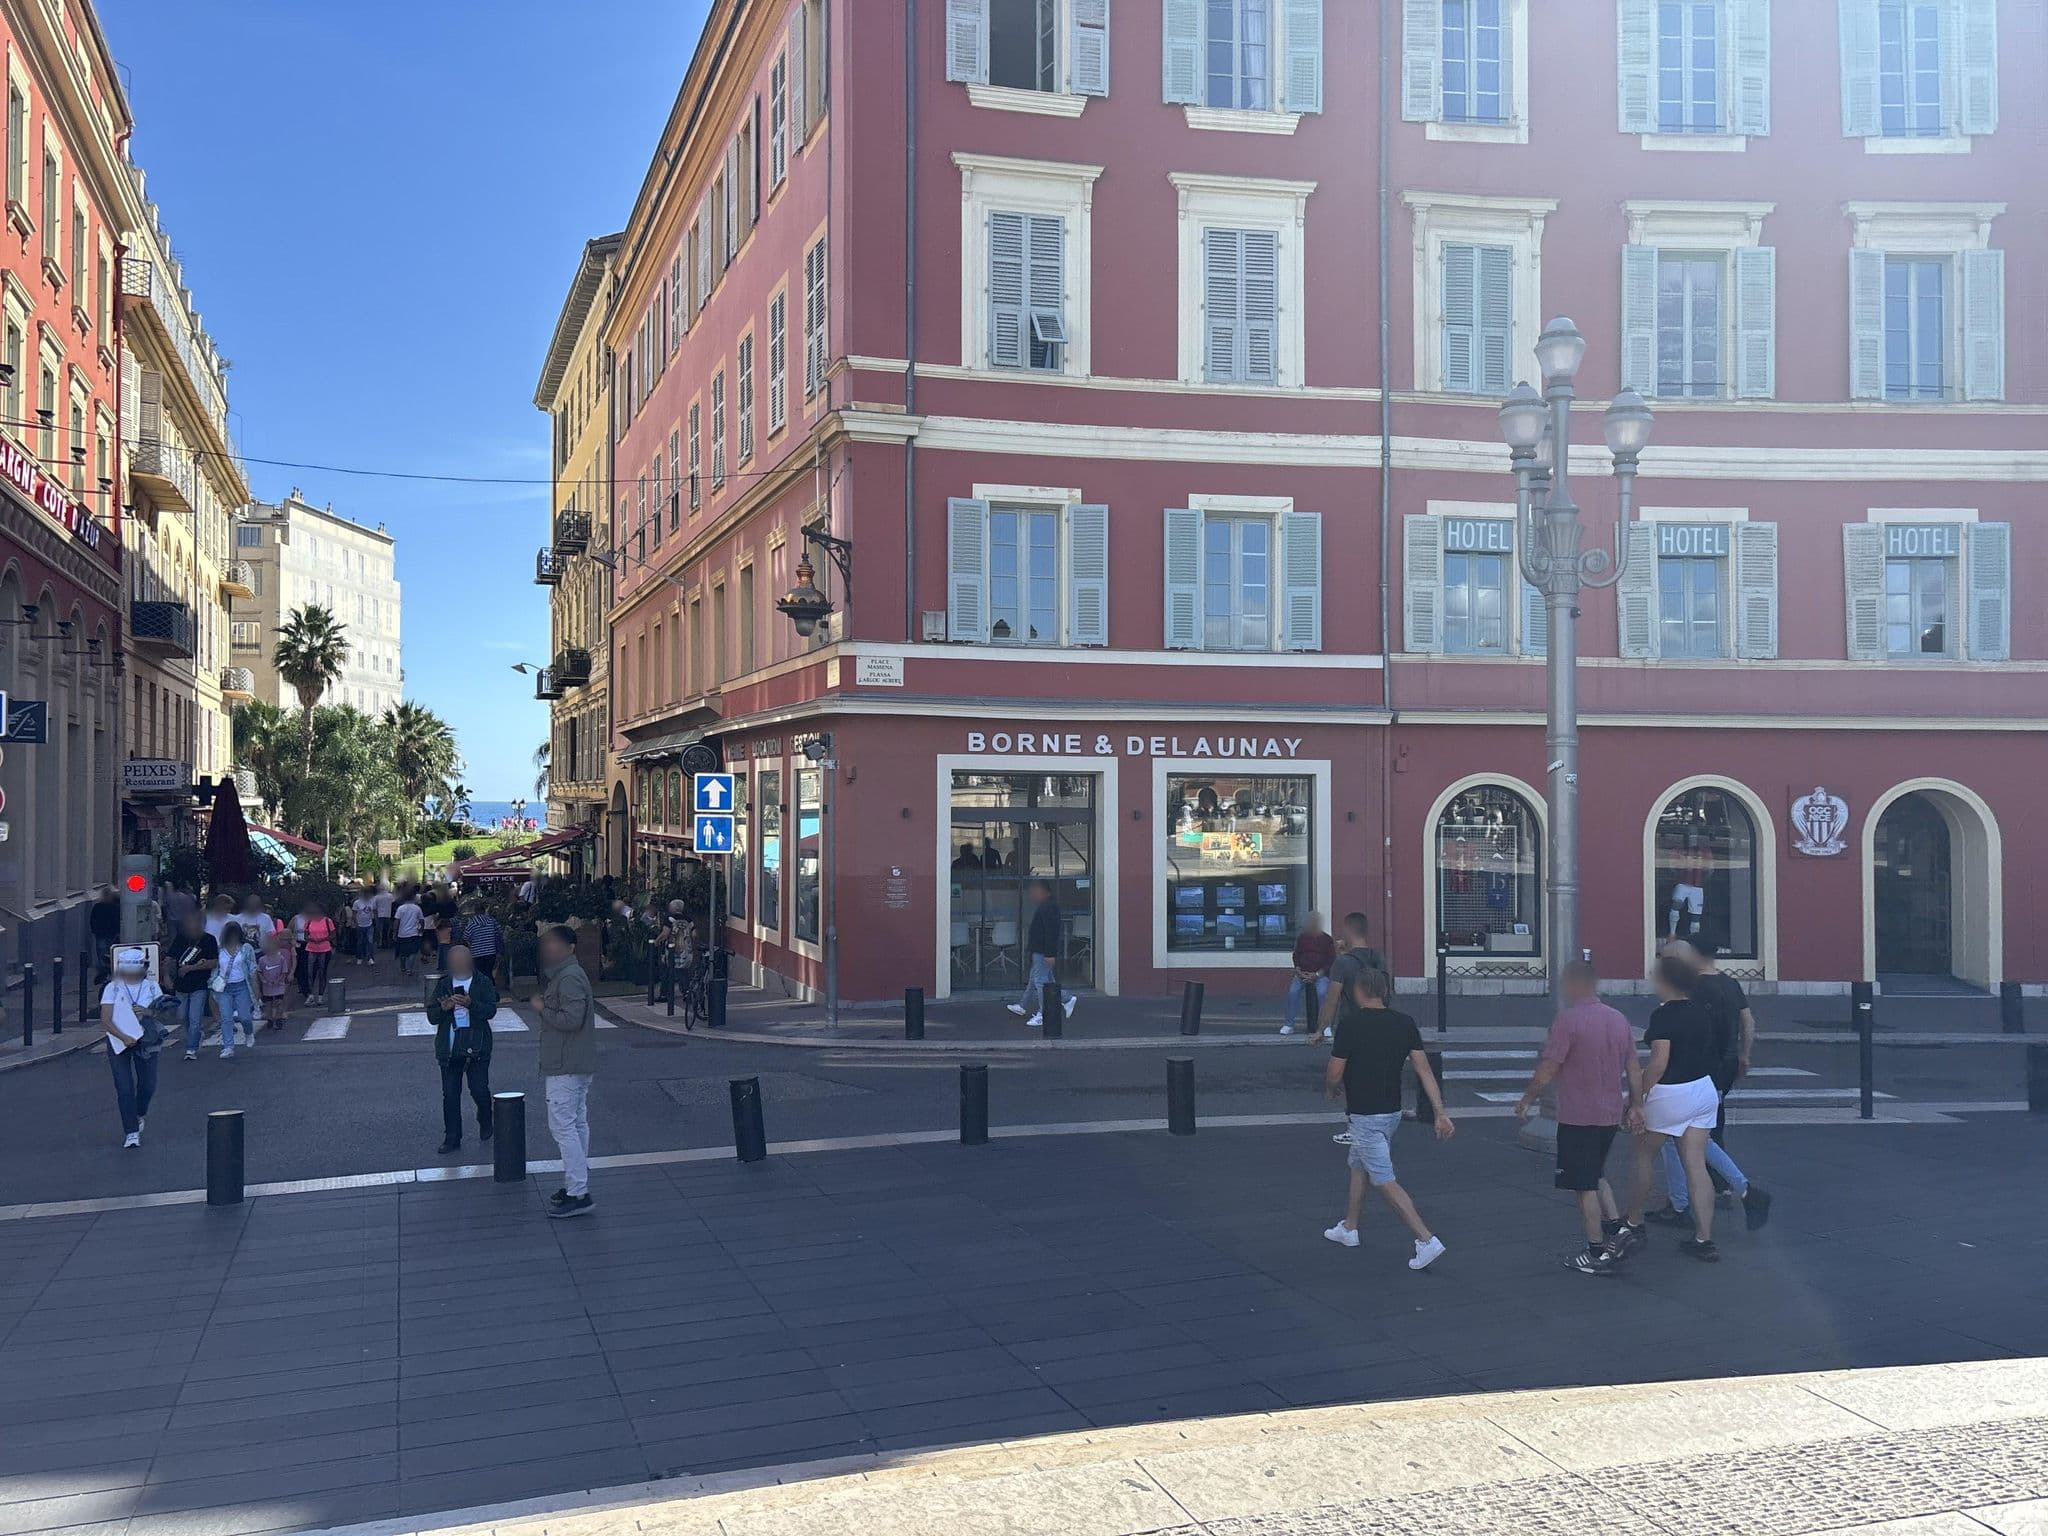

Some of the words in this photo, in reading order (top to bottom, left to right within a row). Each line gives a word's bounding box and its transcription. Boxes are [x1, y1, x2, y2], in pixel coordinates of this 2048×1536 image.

[1447, 520, 1510, 549] HOTEL
[1661, 526, 1726, 554] HOTEL
[1889, 527, 1955, 554] HOTEL
[967, 732, 1082, 754] BORNE
[1094, 734, 1114, 755] &
[1126, 736, 1303, 757] DELAUNAY
[122, 764, 177, 777] PEIXES
[125, 777, 177, 786] Restaurant
